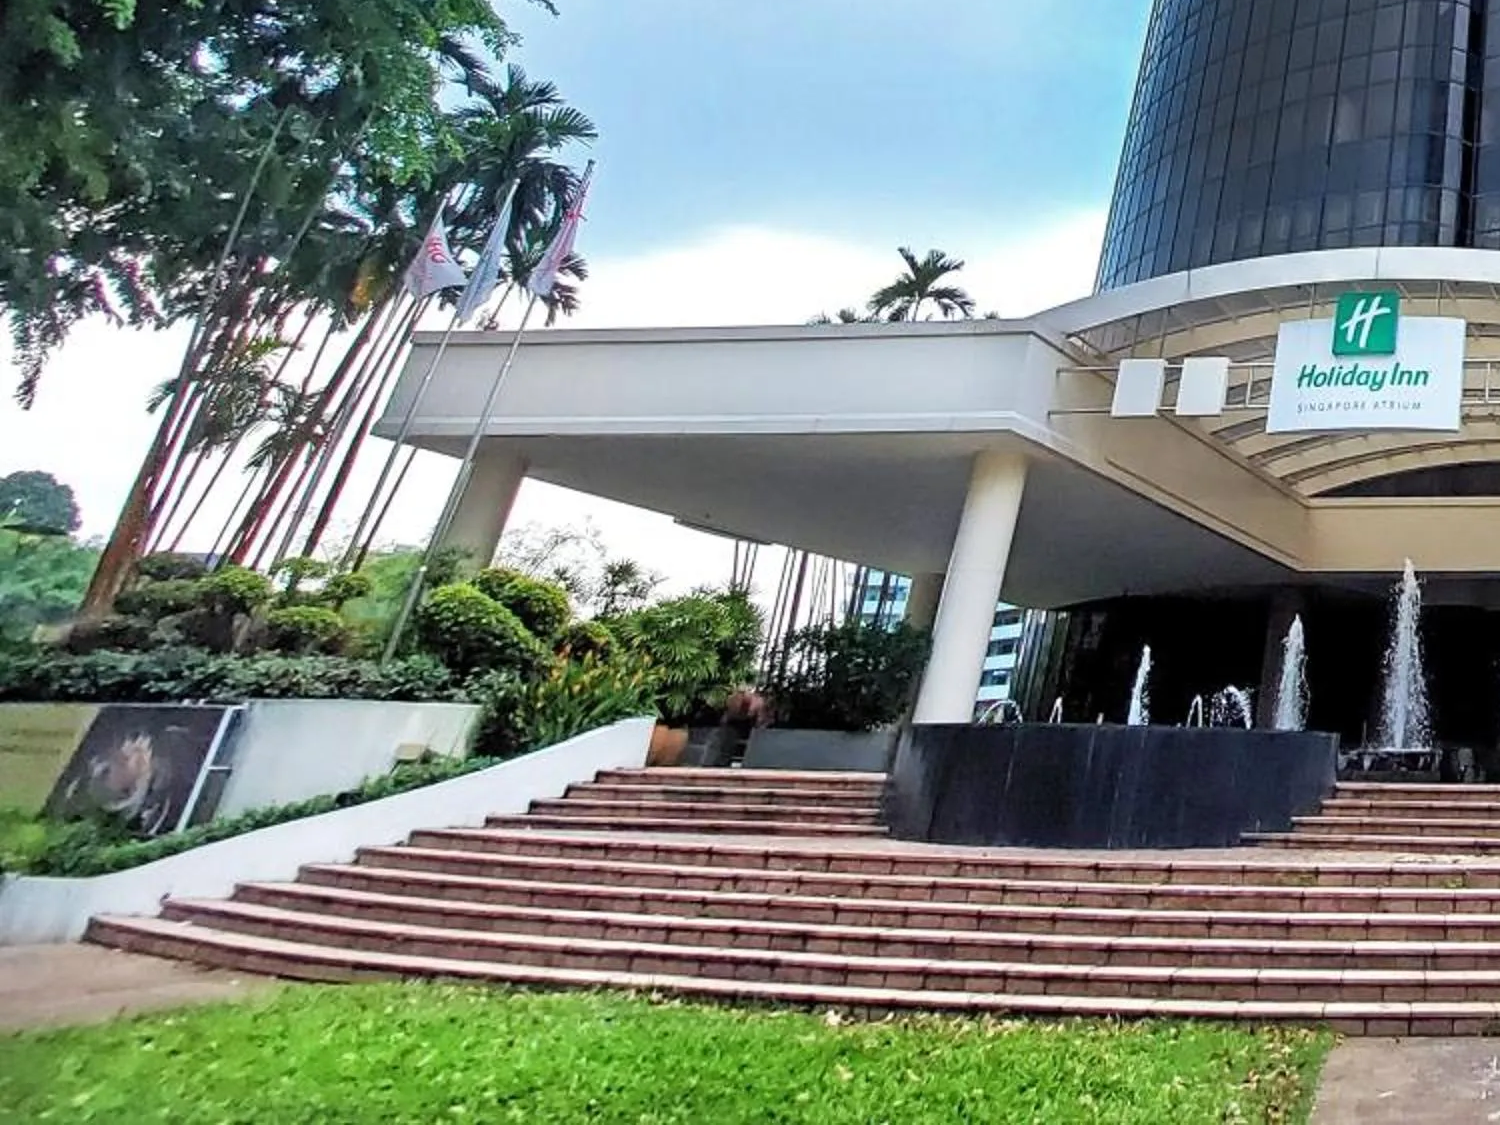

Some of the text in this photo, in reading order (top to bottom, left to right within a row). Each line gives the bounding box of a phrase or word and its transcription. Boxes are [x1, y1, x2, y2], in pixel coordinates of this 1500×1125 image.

[1297, 362, 1430, 392] Holiday Inn
[1296, 400, 1422, 414] SINGAPORE ATRIUM
